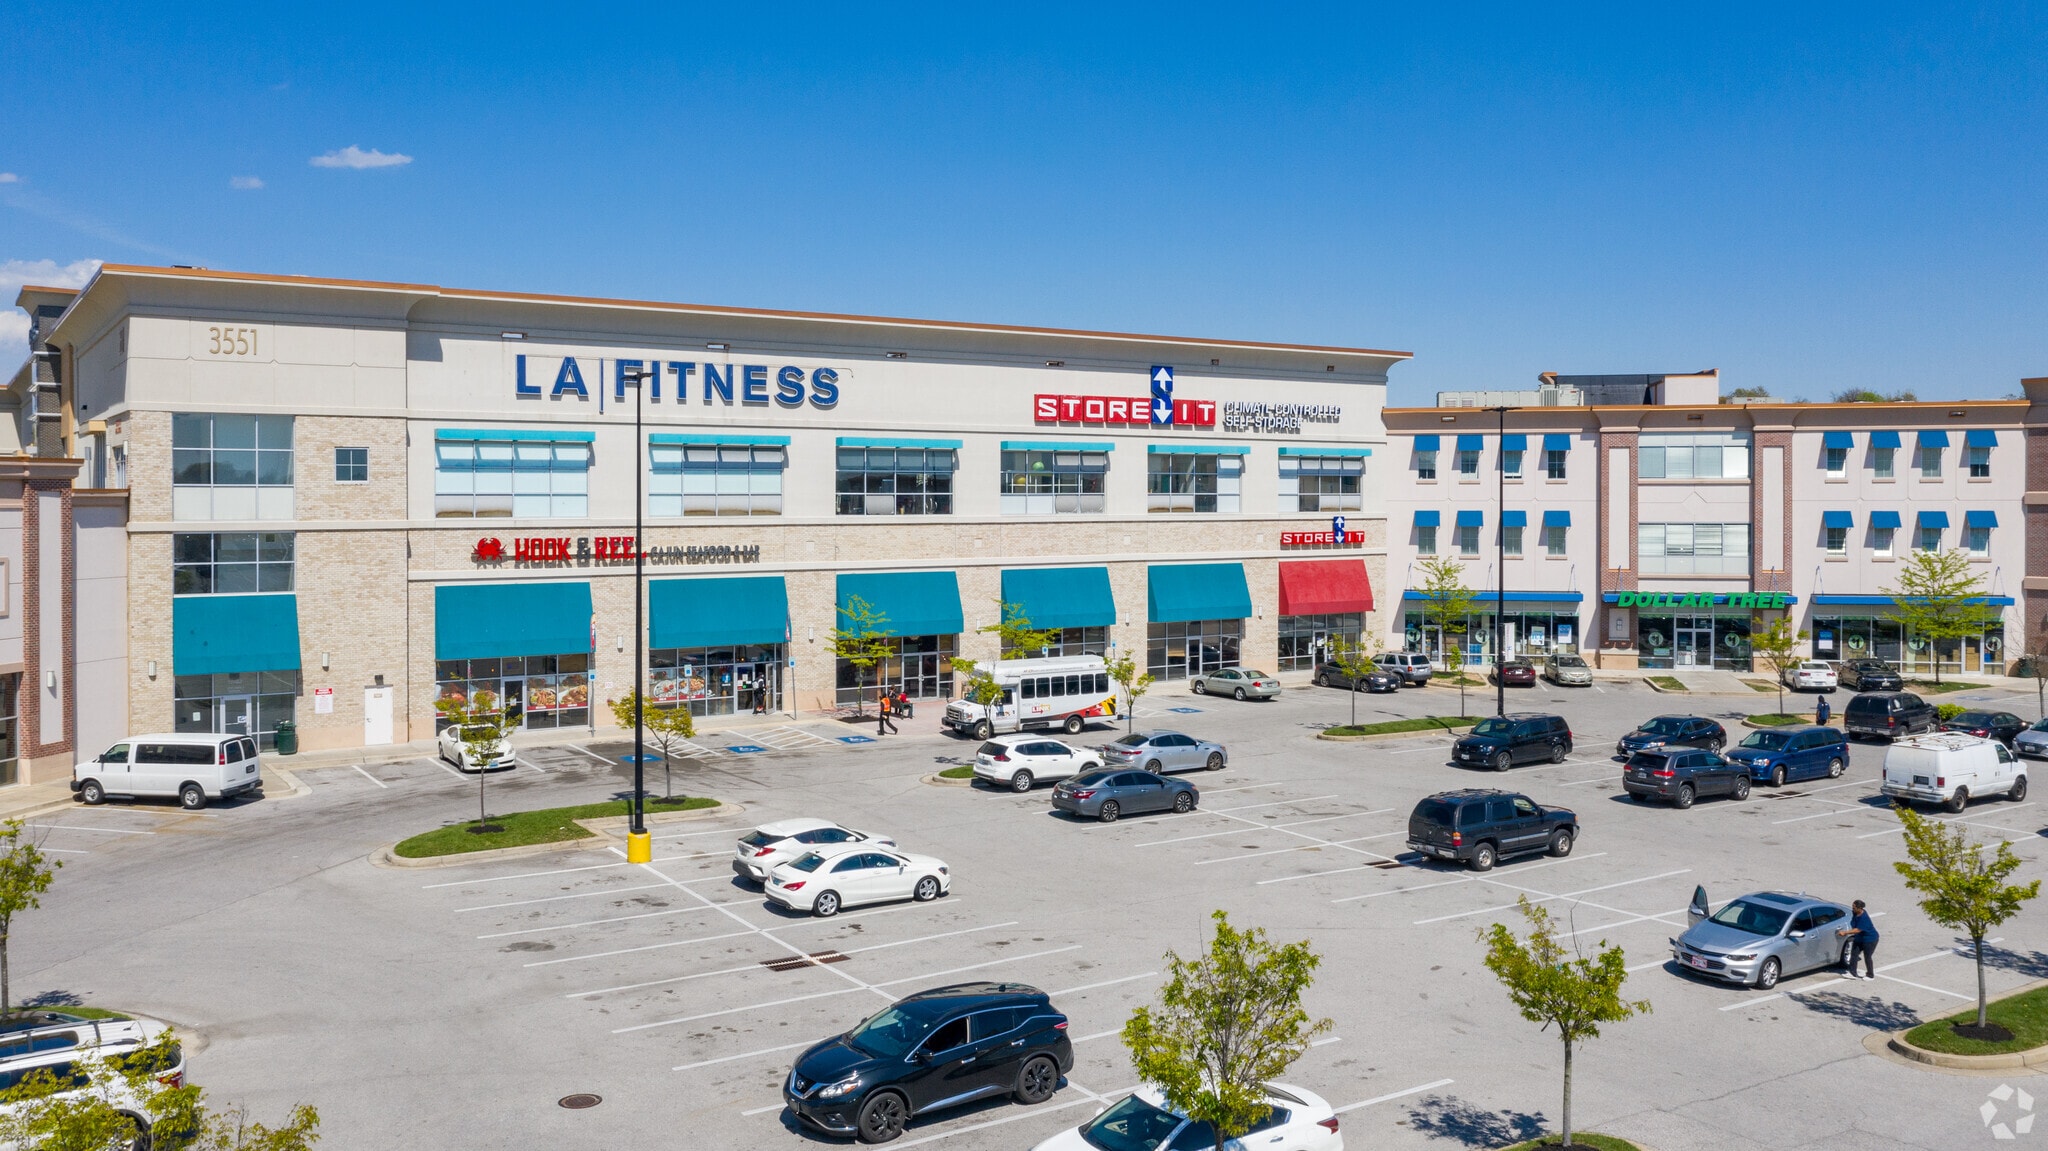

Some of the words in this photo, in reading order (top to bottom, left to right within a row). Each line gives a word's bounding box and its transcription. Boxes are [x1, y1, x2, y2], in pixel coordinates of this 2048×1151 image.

[208, 327, 258, 356] 3551
[515, 353, 590, 398] LA
[614, 358, 840, 407] FITNESS
[1037, 397, 1151, 420] STORE
[1182, 403, 1215, 421] IT
[1225, 415, 1251, 427] SELF
[1254, 416, 1302, 429] STORAGE
[1282, 532, 1334, 543] STORE
[1347, 532, 1364, 542] IT
[514, 537, 573, 562] HOOK
[576, 536, 591, 561] &
[650, 546, 684, 557] CAJUN
[686, 545, 732, 557] SEAFOOD
[742, 544, 761, 556] BAR
[1617, 591, 1715, 608] DOLLAR
[1726, 591, 1788, 609] TREE
